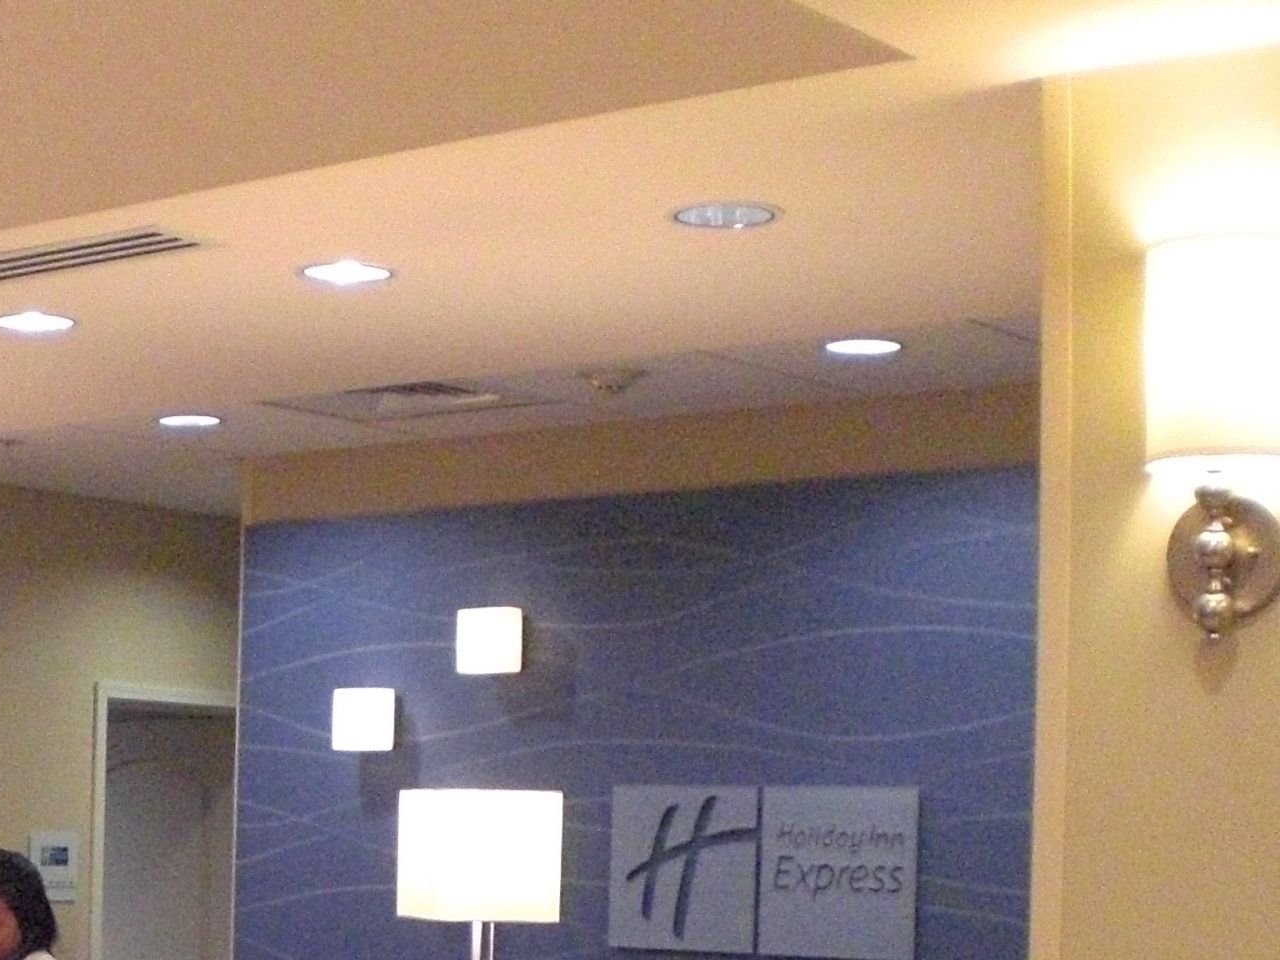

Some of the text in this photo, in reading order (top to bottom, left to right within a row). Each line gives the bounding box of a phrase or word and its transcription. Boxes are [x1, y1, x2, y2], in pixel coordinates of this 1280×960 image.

[776, 823, 905, 854] Holiday Inn
[774, 855, 904, 902] Express
